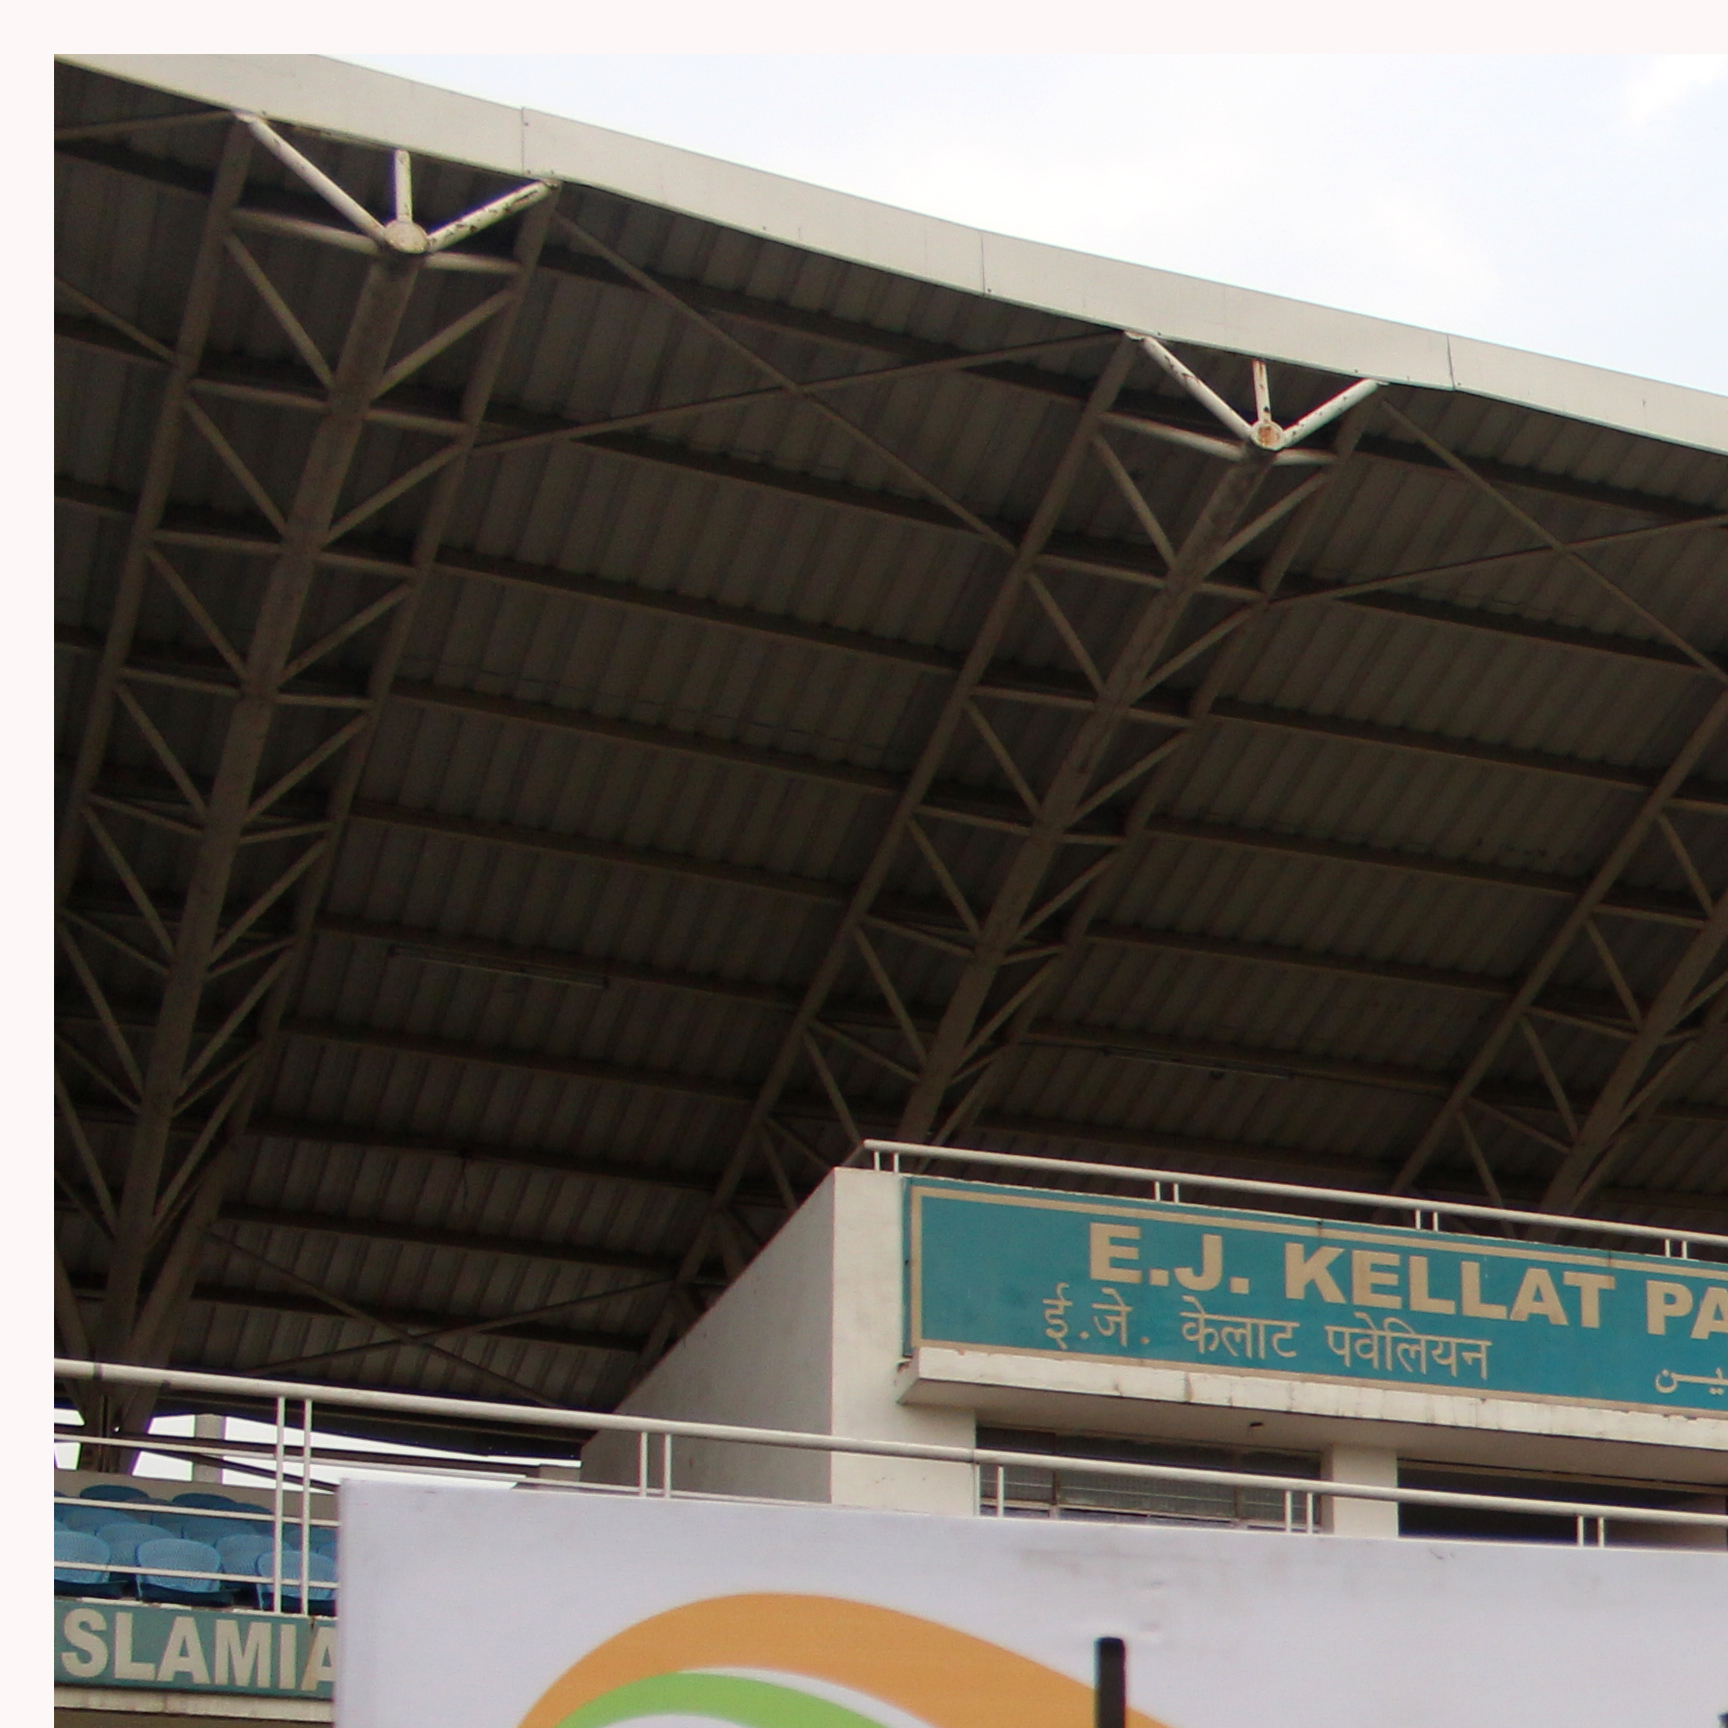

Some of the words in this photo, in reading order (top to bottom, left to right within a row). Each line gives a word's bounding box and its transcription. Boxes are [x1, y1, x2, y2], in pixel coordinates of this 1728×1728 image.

[1088, 1222, 1250, 1295] E.J.
[1284, 1241, 1617, 1330] KELLAT
[1180, 1296, 1301, 1361] केलाट
[1324, 1312, 1494, 1382] पवेलियन
